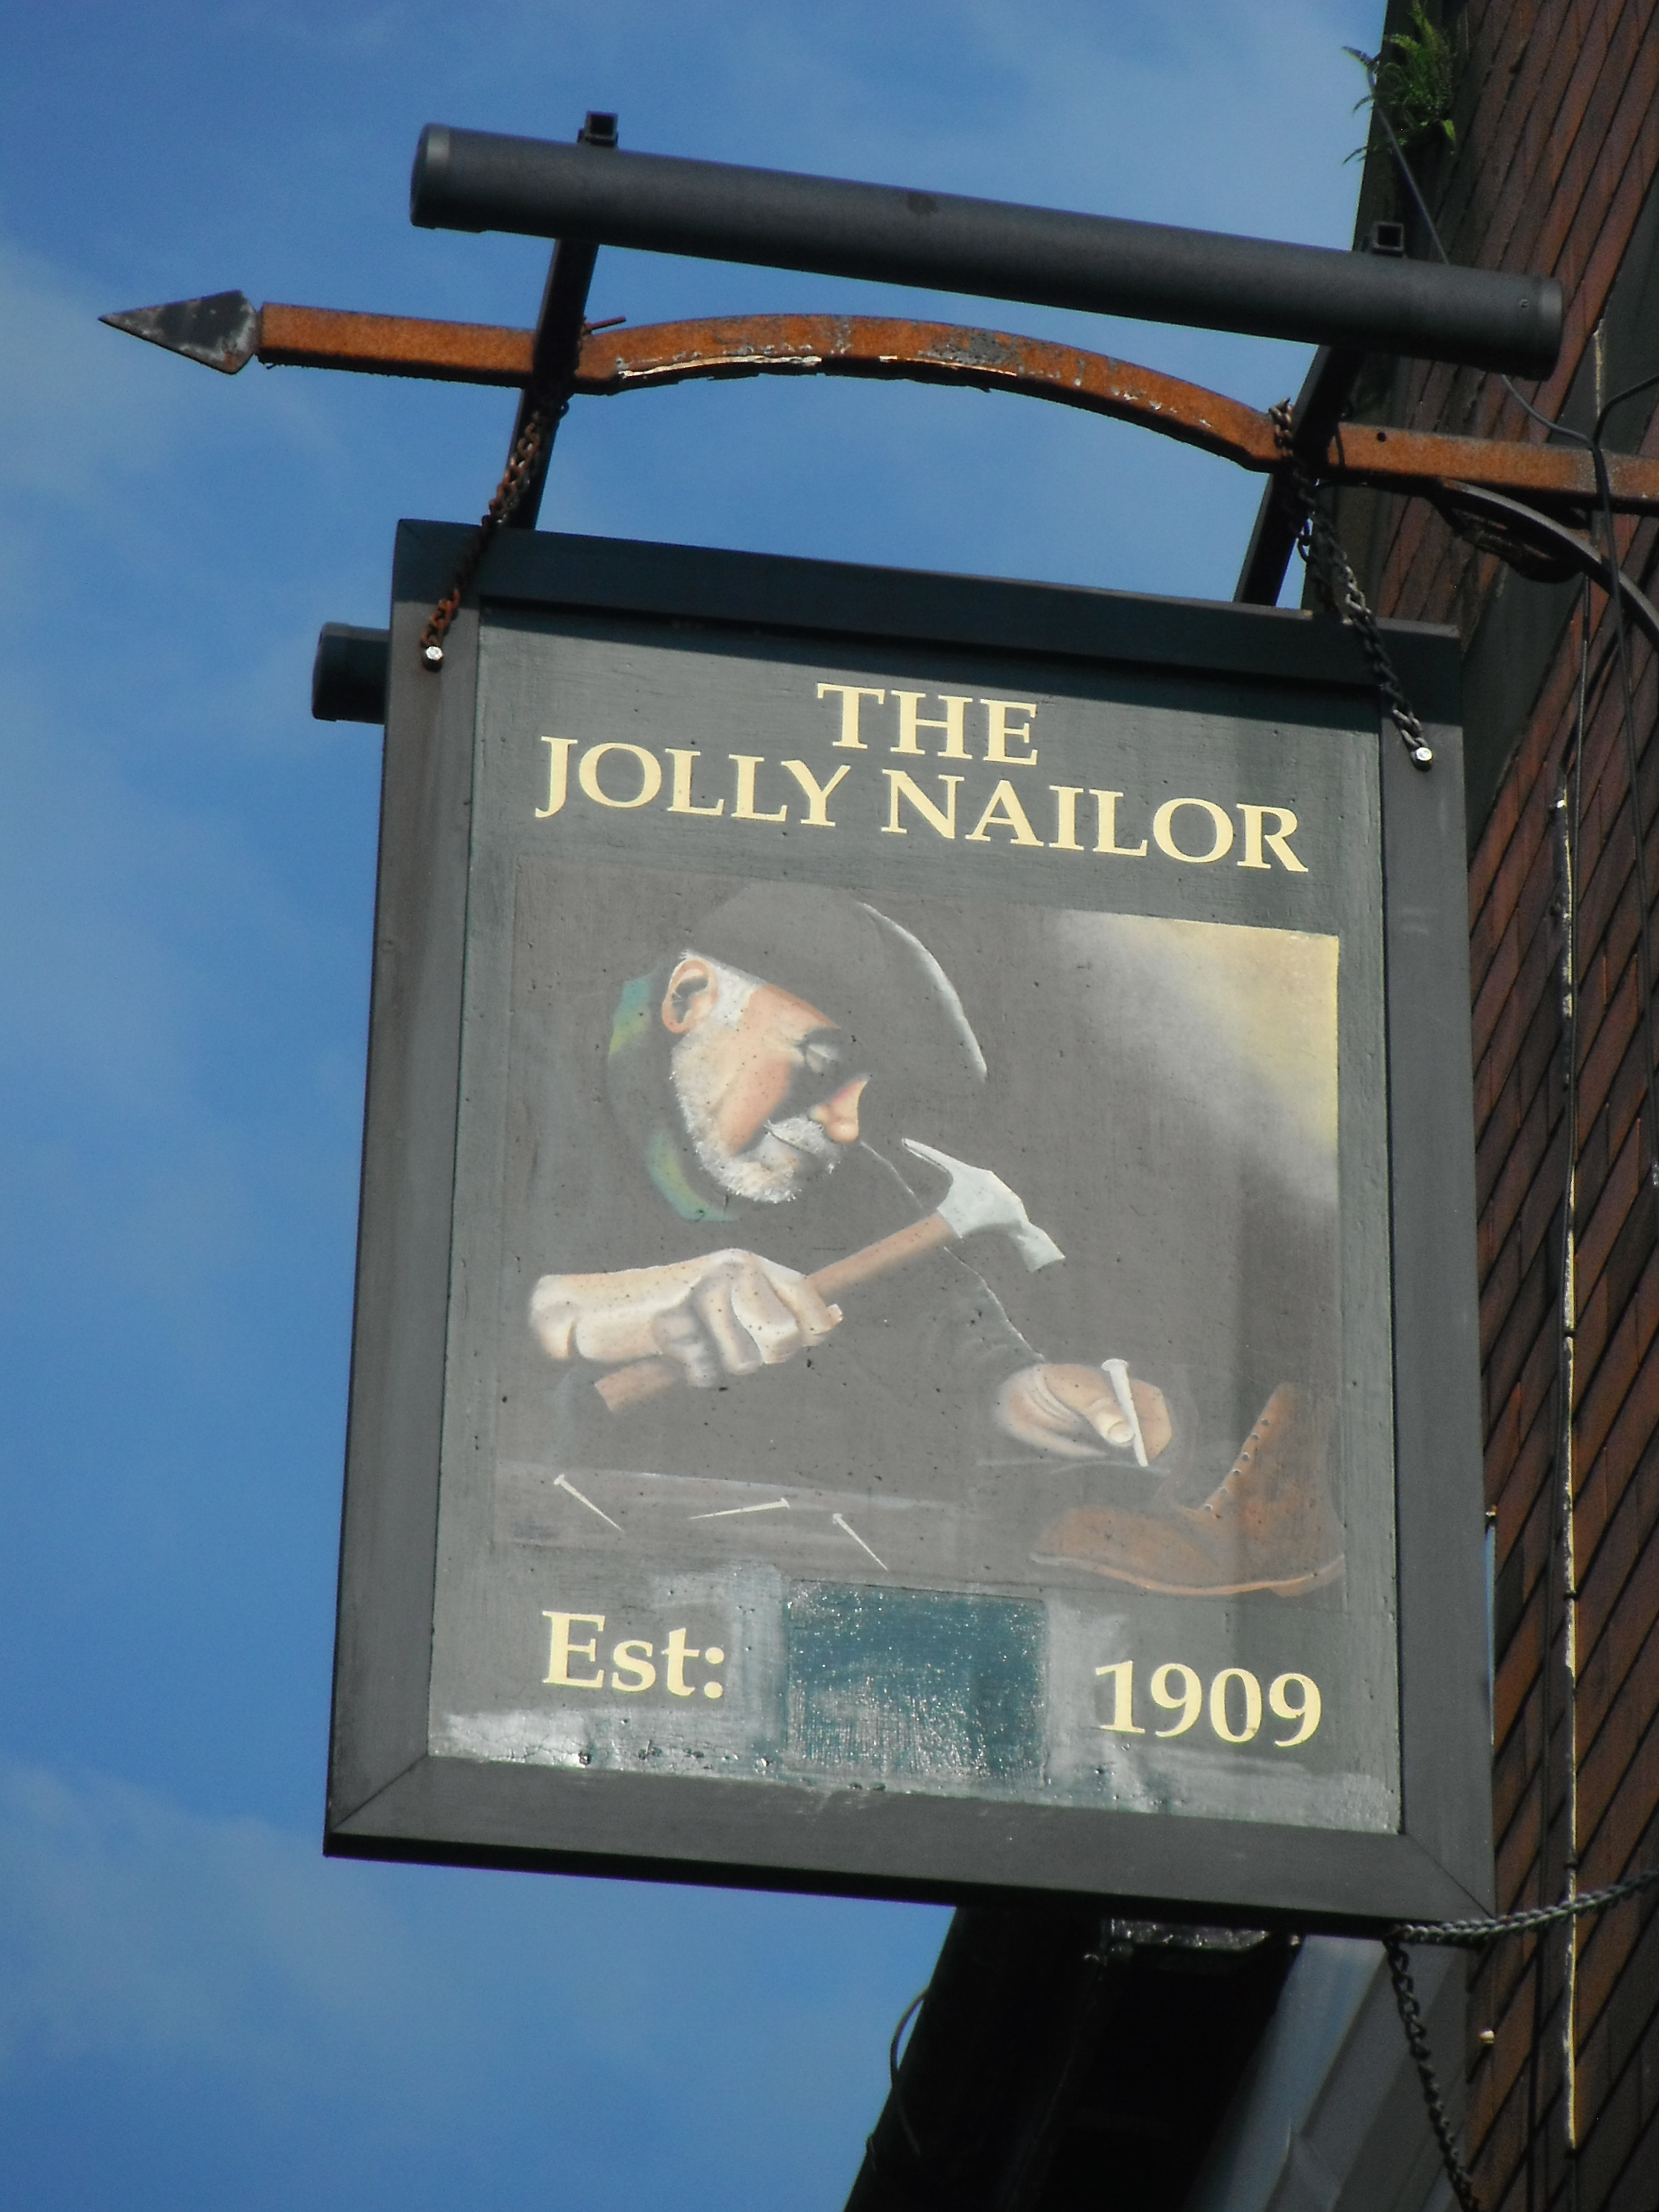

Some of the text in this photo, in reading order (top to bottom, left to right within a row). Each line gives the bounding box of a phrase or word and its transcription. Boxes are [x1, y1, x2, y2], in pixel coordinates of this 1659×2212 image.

[816, 682, 1039, 766] THE
[534, 735, 1310, 873] JOLLY NAILOR
[541, 1609, 1322, 1748] Est: 1909
